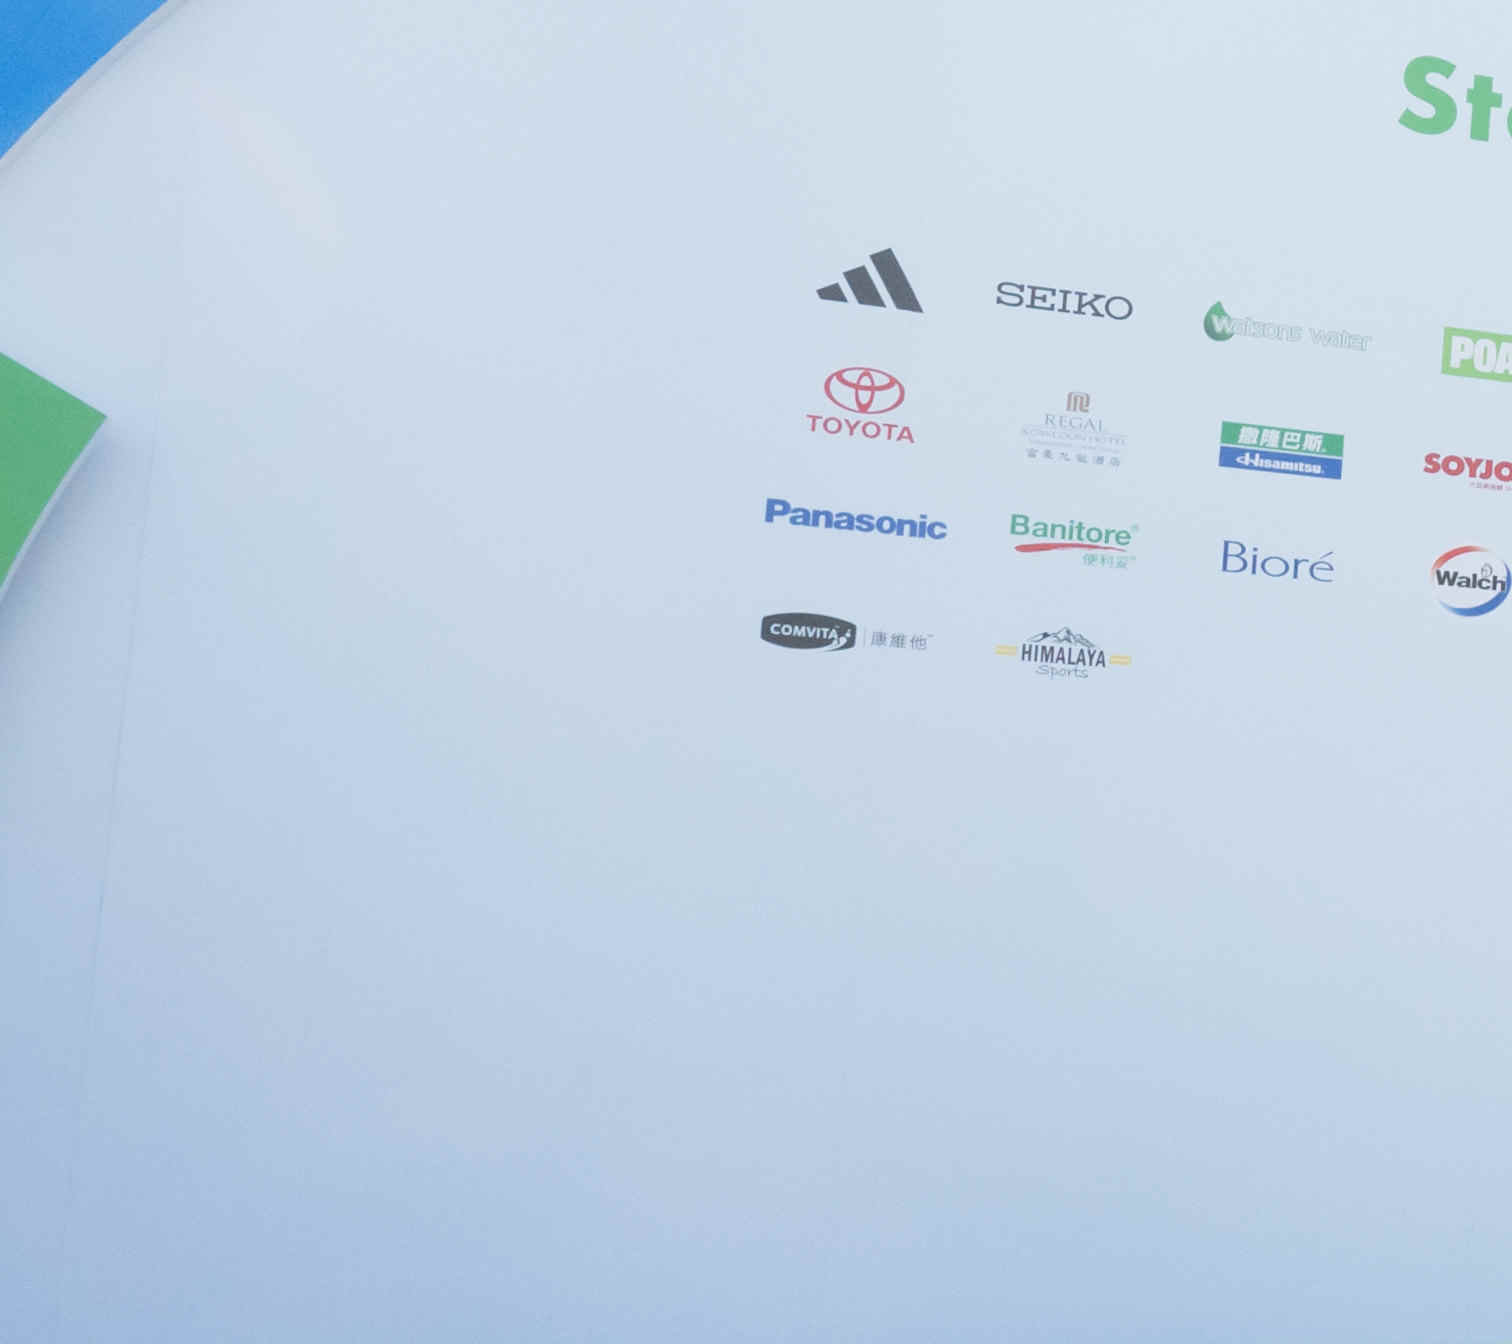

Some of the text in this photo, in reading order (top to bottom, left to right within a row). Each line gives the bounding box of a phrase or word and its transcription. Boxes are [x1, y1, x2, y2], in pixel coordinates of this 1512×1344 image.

[995, 280, 1134, 321] SEIKO
[805, 414, 916, 445] TOYOTA
[764, 497, 948, 541] Panasonic
[1009, 513, 1132, 547] Banitore
[1220, 539, 1335, 583] Bioré
[1435, 565, 1507, 593] Walch
[769, 622, 840, 642] COMVITA
[1020, 643, 1107, 668] HIMALAYA
[1036, 663, 1090, 680] Sports
